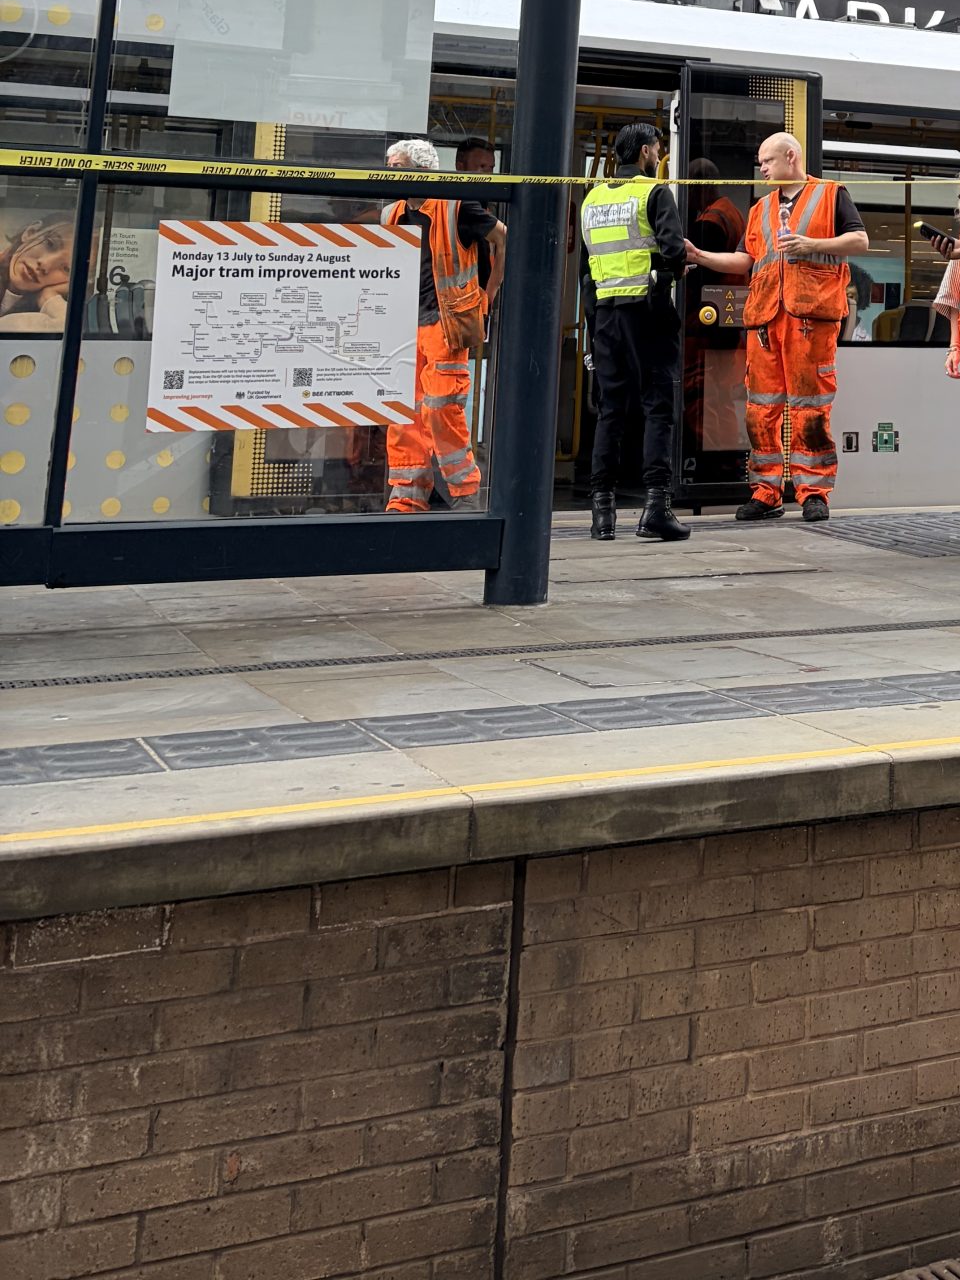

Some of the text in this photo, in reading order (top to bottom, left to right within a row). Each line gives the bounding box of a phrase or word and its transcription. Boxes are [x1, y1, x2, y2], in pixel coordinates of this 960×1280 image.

[19, 155, 52, 166] ENTER
[56, 157, 75, 168] NOT
[78, 159, 92, 169] DO
[102, 160, 133, 171] SCENE
[136, 161, 167, 172] CRIME
[202, 165, 232, 175] ENTER
[172, 251, 351, 264] Monday 13 July to Sunday 2 August
[172, 265, 401, 282] Major tram improvement works
